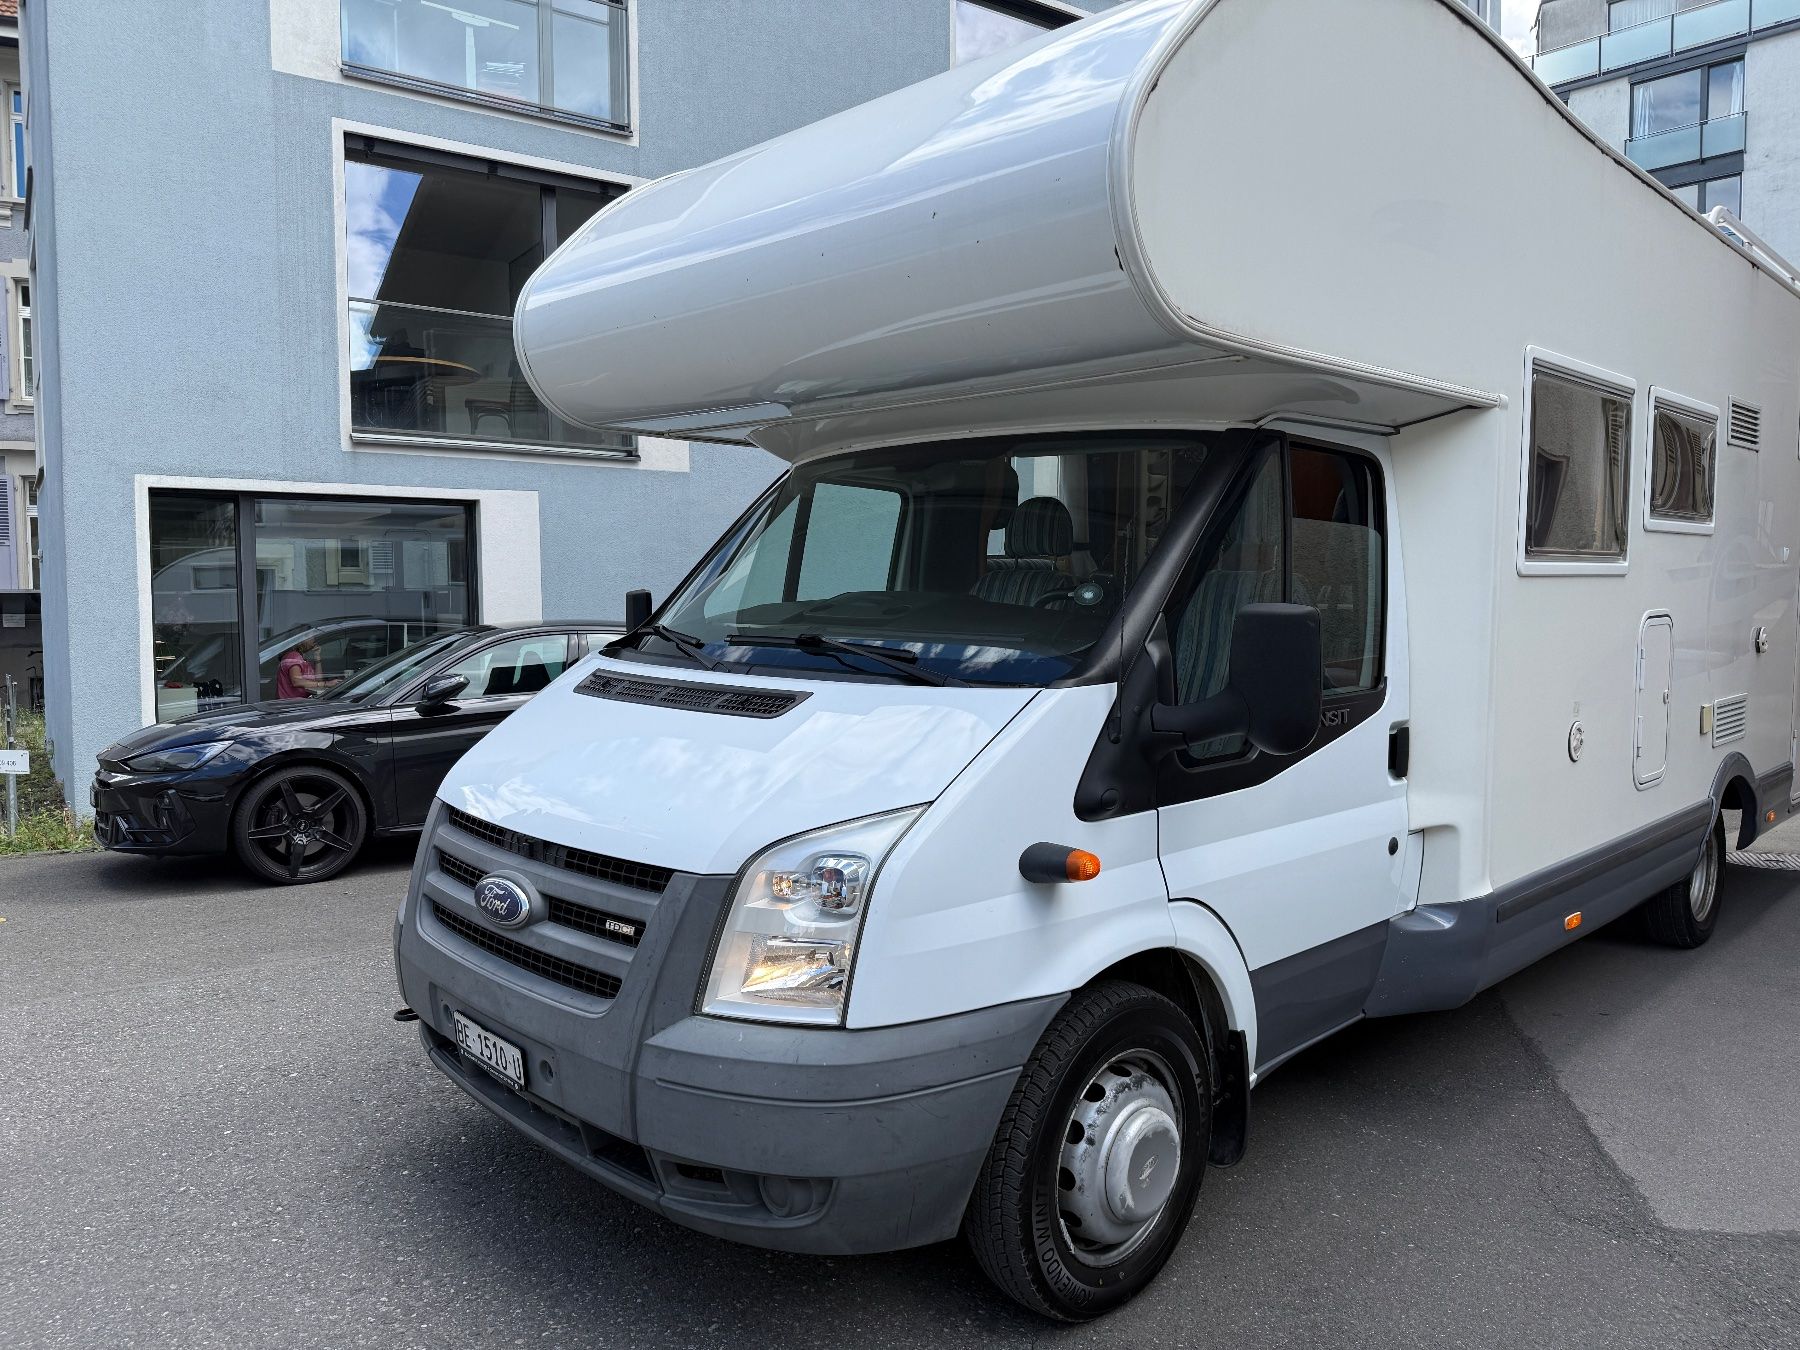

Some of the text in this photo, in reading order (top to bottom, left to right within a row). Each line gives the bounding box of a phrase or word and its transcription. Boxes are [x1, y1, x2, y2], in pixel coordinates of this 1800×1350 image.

[1320, 708, 1350, 727] NSIT
[480, 884, 511, 915] Ford
[456, 1019, 473, 1051] BE
[477, 1033, 508, 1072] 1510
[1034, 1180, 1051, 1247] WINT
